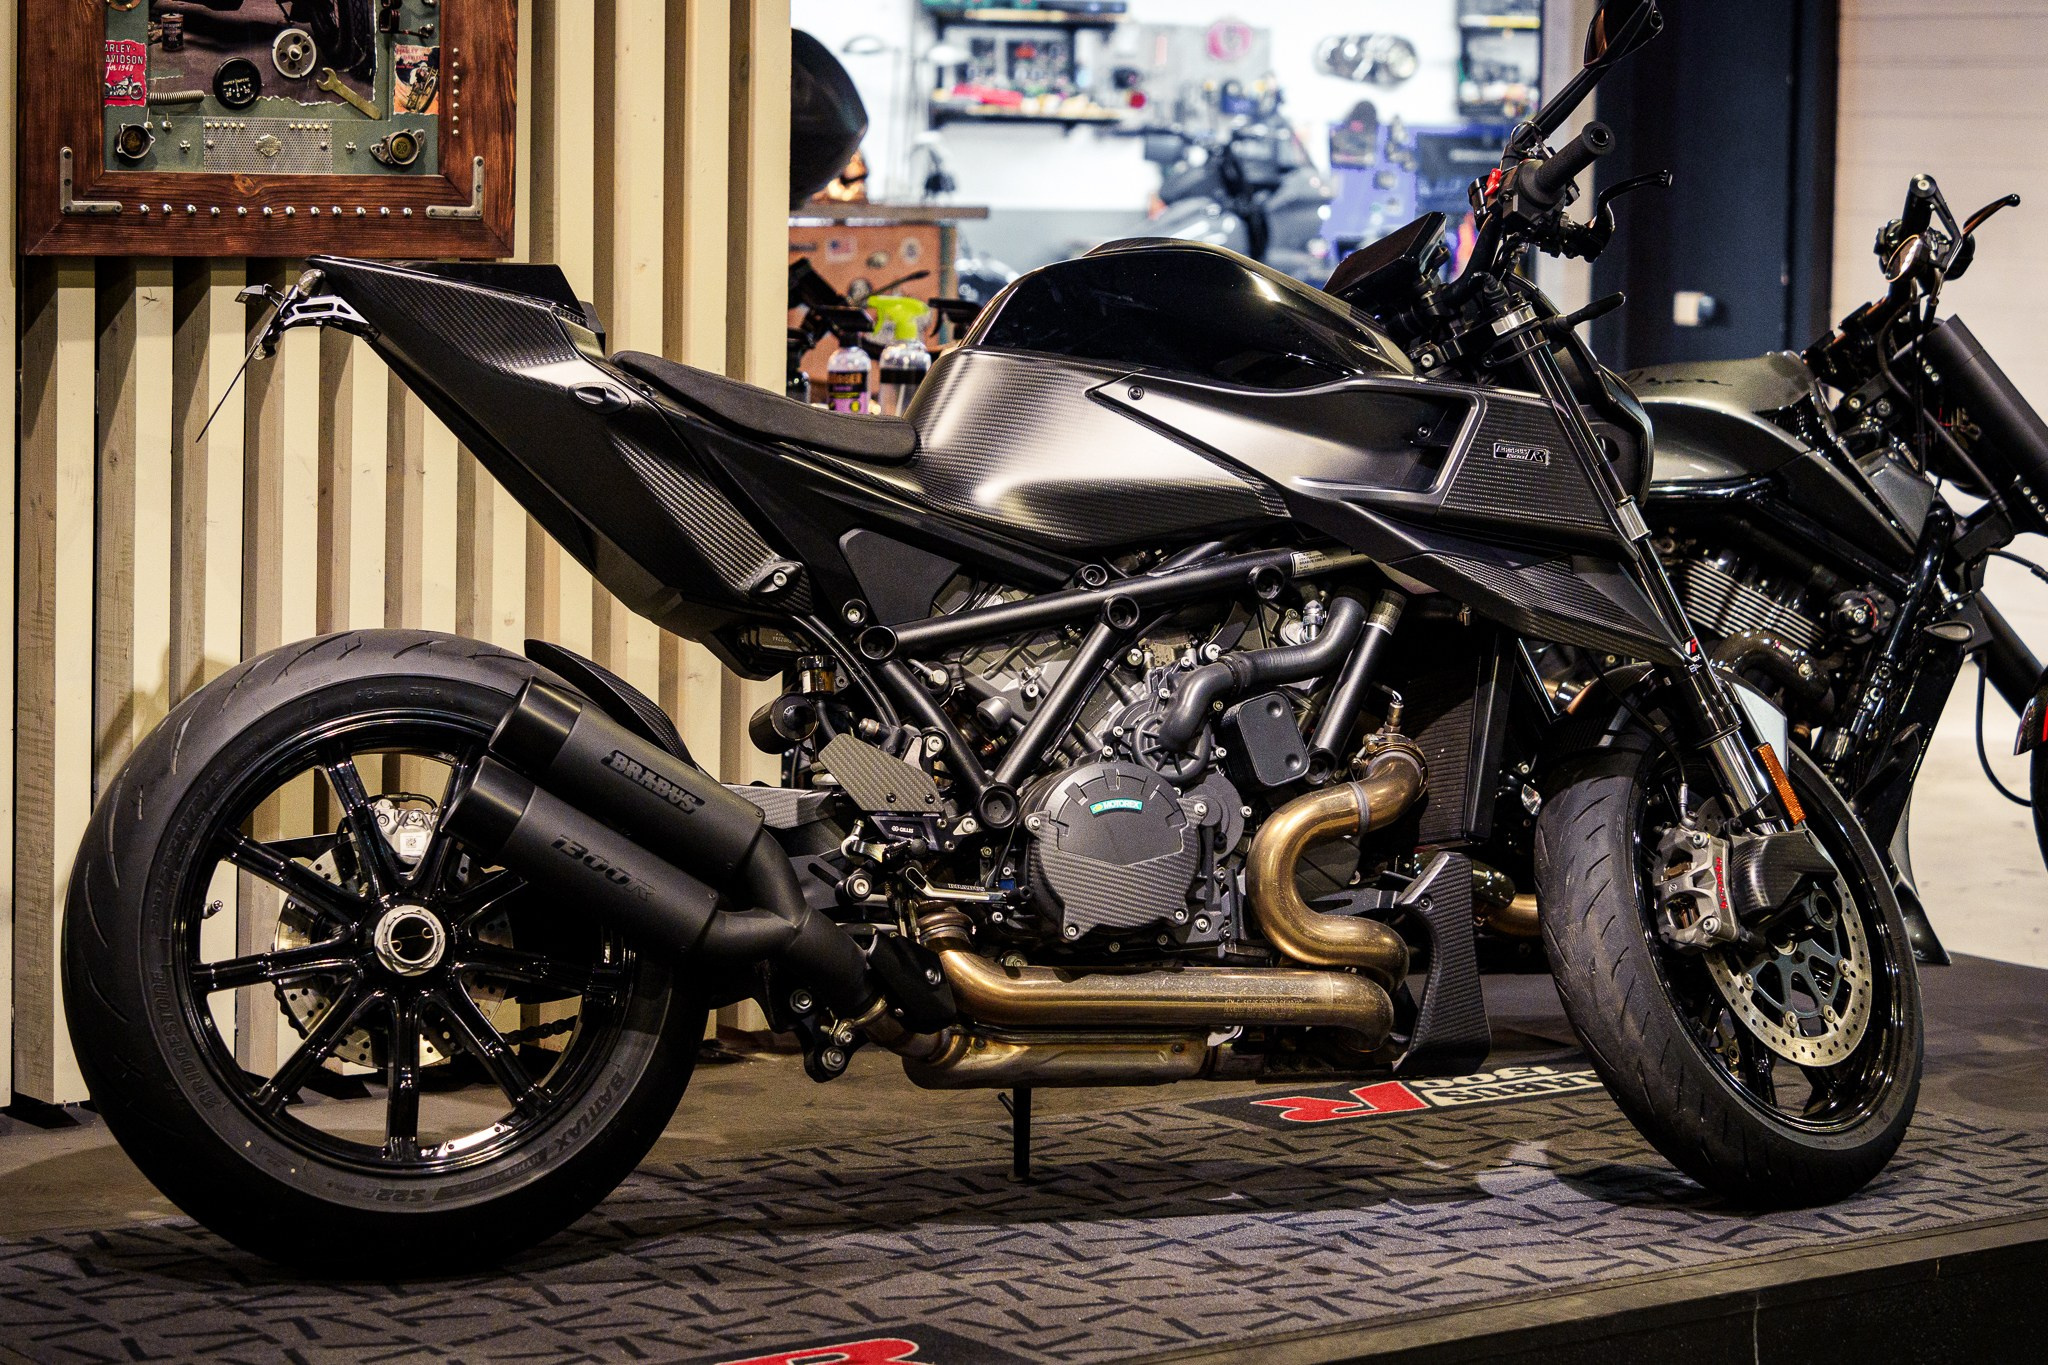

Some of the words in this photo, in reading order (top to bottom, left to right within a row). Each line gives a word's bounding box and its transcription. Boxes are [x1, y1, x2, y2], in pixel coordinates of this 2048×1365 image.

[105, 43, 136, 53] ARLEY-
[105, 54, 143, 65] AVIDSON
[610, 753, 701, 814] BRABUS
[1103, 799, 1141, 810] MOTOREX
[1715, 856, 1729, 909] brembo
[148, 968, 221, 1112] BRIDGESTONE
[1410, 1066, 1558, 1088] 1300
[1434, 1073, 1600, 1102] ABUS
[551, 1069, 628, 1155] BATTLAX
[375, 1188, 426, 1201] S22
